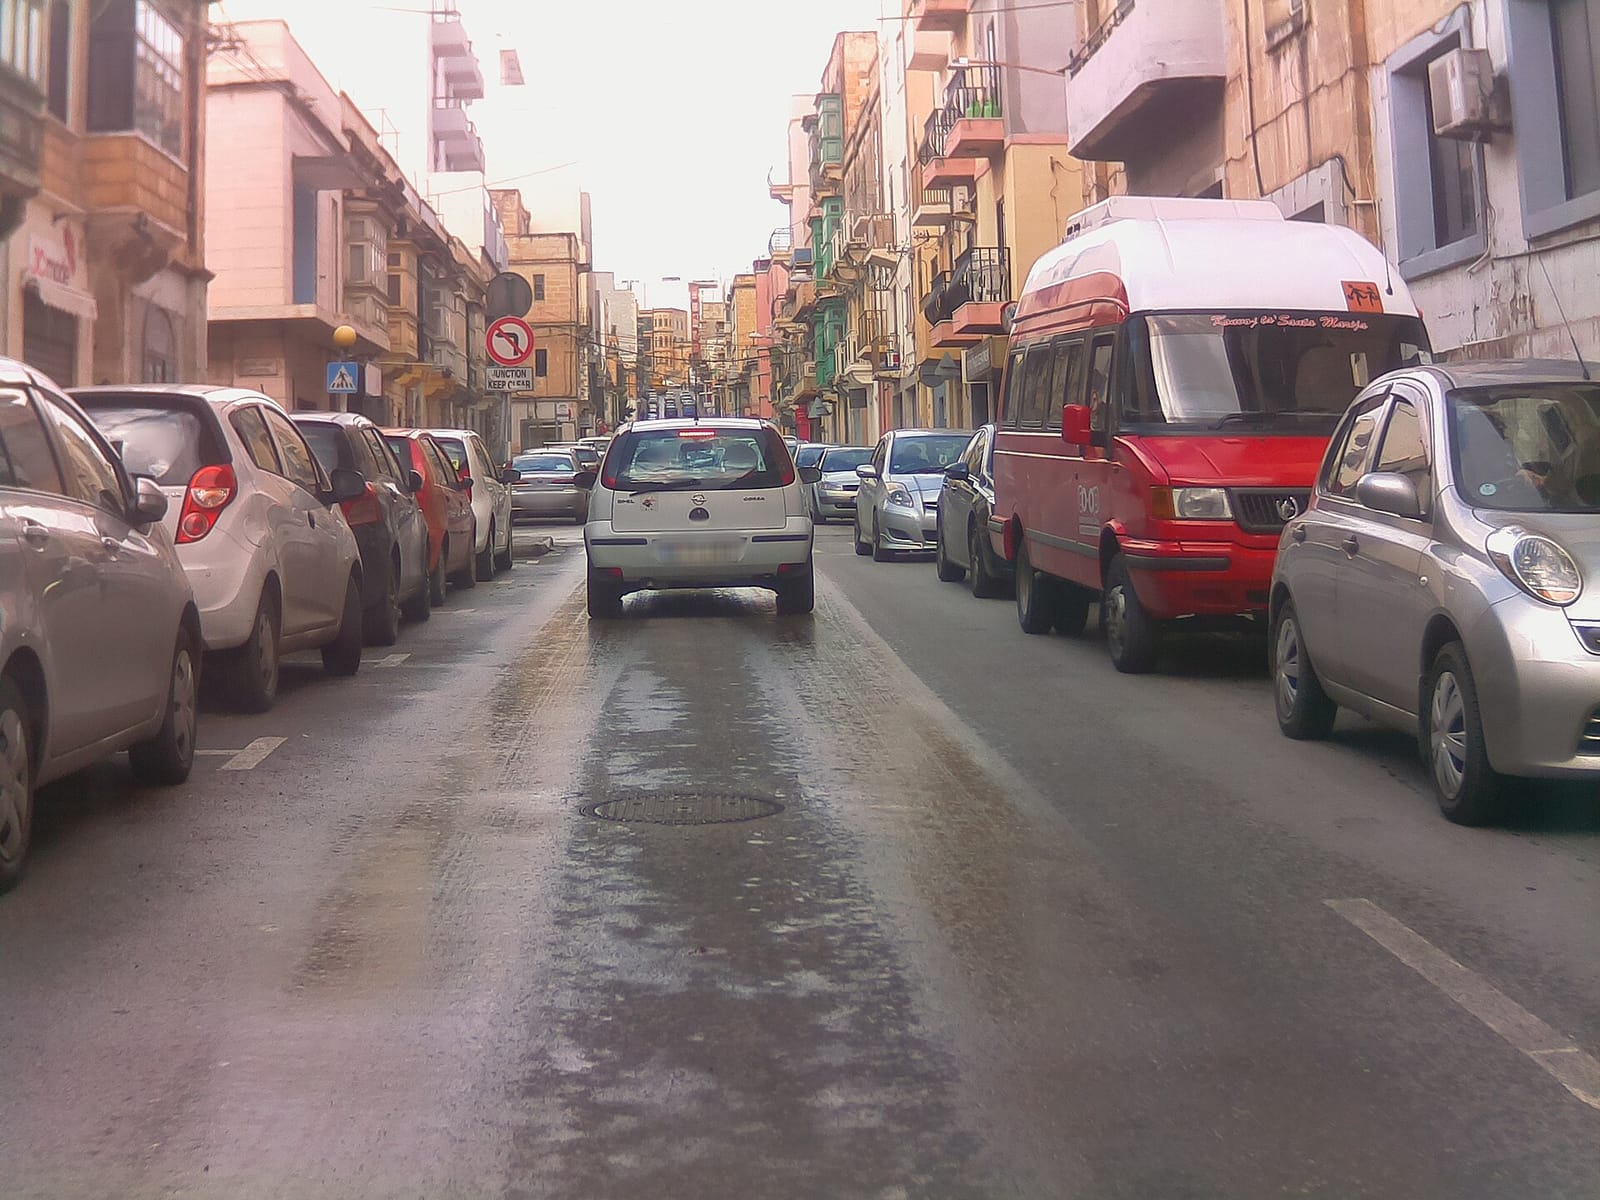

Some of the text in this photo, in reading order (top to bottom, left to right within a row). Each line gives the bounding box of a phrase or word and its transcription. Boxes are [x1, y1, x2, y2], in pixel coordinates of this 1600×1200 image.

[1277, 314, 1317, 327] Santa
[1319, 315, 1369, 331] Marija
[487, 380, 506, 389] KEEP
